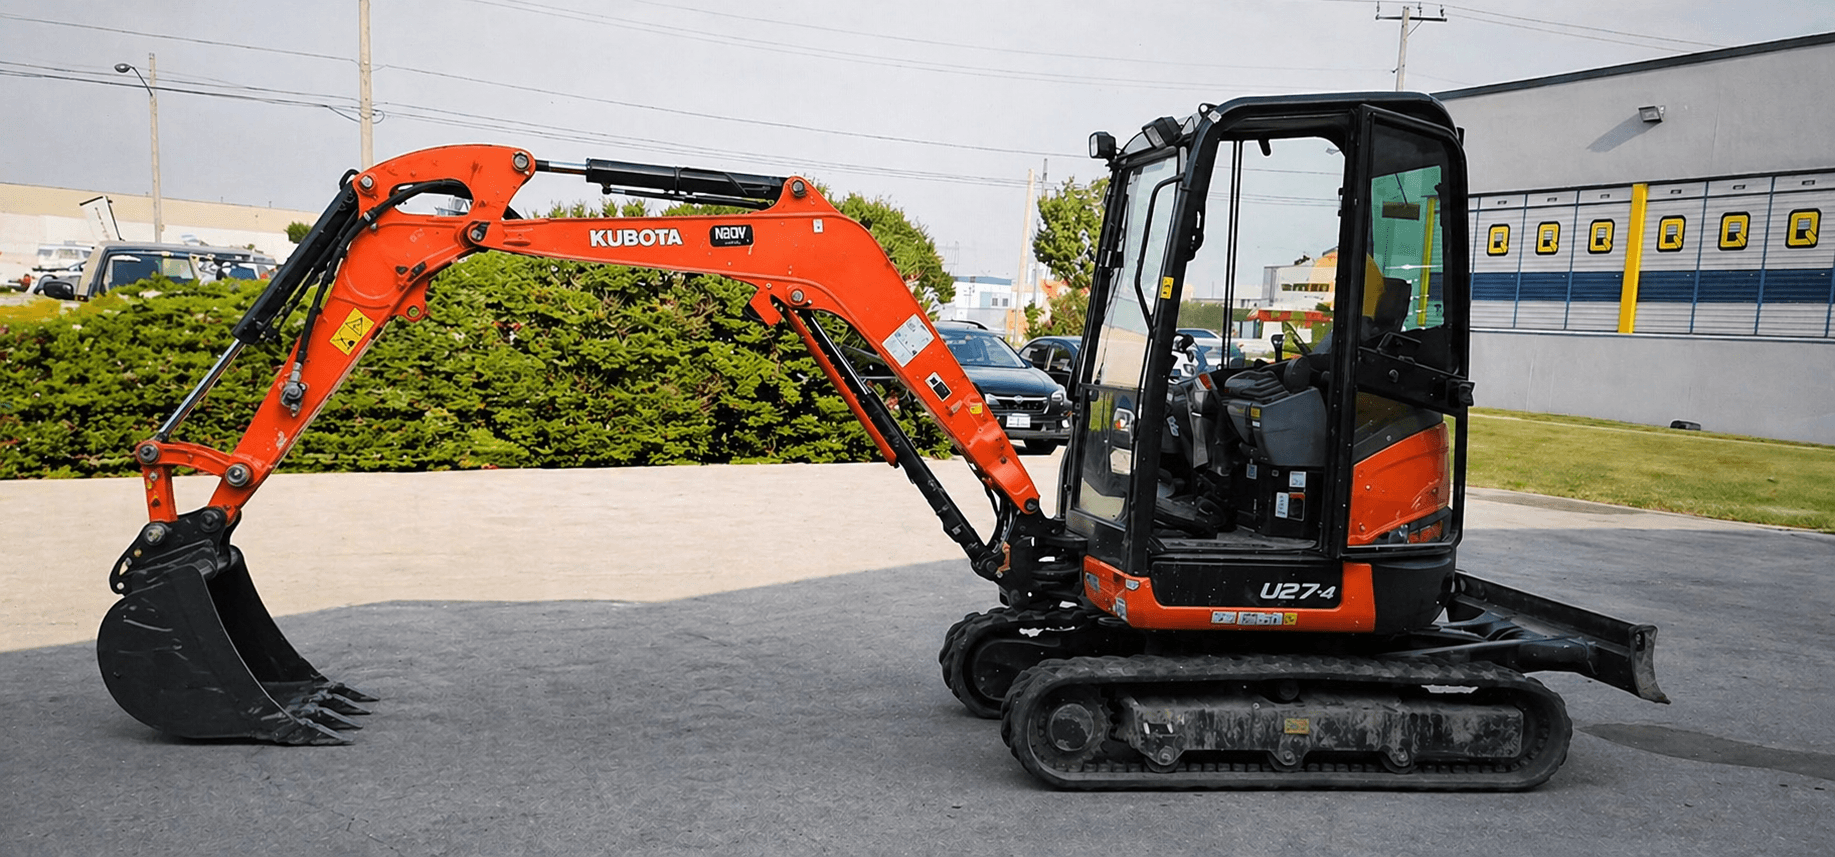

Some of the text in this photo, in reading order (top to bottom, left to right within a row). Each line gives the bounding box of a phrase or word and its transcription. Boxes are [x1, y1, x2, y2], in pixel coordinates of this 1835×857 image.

[589, 229, 683, 247] KUBOTA
[1488, 225, 1510, 254] Q
[1536, 223, 1560, 253] Q
[1589, 221, 1614, 252] Q
[1658, 217, 1685, 249] Q
[1719, 214, 1749, 248] Q
[1786, 210, 1820, 246] Q
